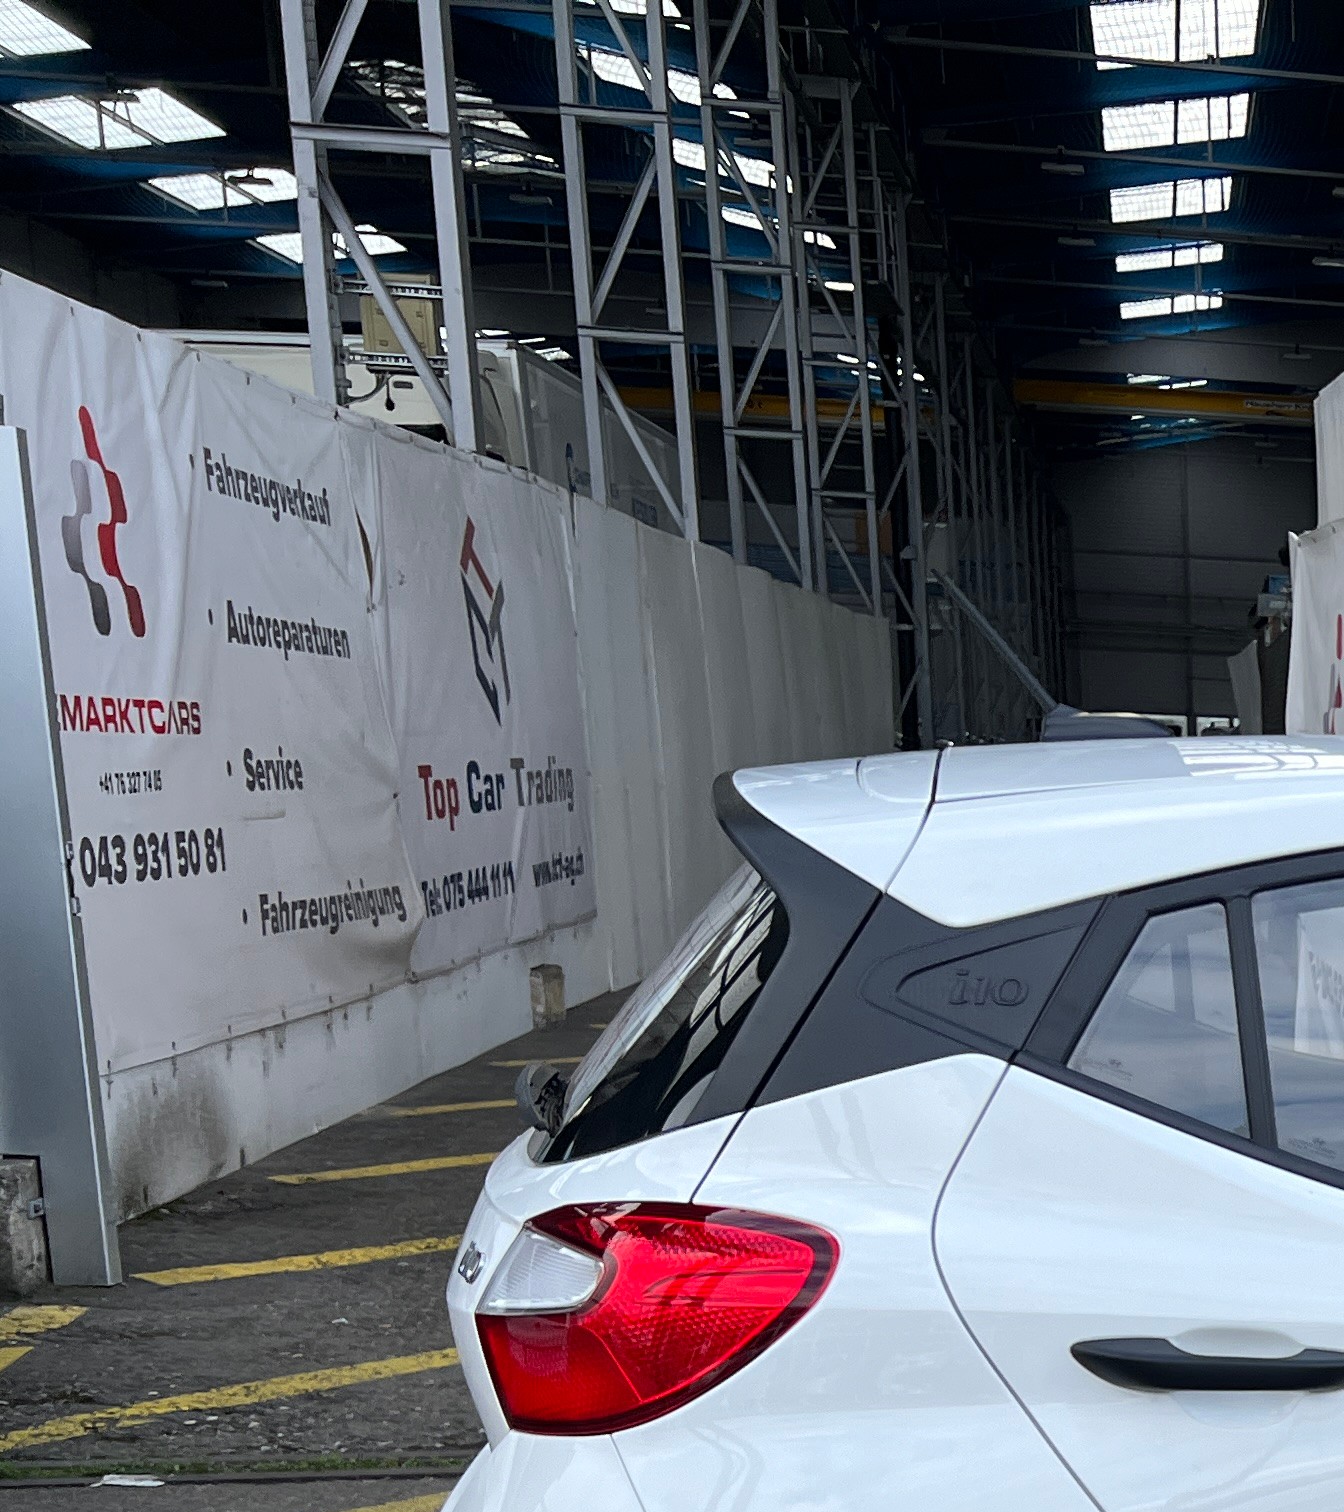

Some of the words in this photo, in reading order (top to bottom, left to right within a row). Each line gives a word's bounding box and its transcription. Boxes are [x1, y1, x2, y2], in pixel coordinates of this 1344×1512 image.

[203, 446, 331, 526] Fahrzeugverkauf
[226, 599, 350, 661] Autoreparaturen
[243, 745, 304, 792] Service
[417, 764, 461, 831] Top
[466, 760, 505, 813] Car
[510, 755, 575, 812] Trading
[79, 834, 127, 888] 043
[133, 831, 173, 882] 931
[174, 829, 201, 877] 50
[204, 826, 227, 873] 81
[258, 877, 407, 937] Fahrzeugreinigung
[442, 871, 465, 913] 075
[467, 865, 490, 905] 444
